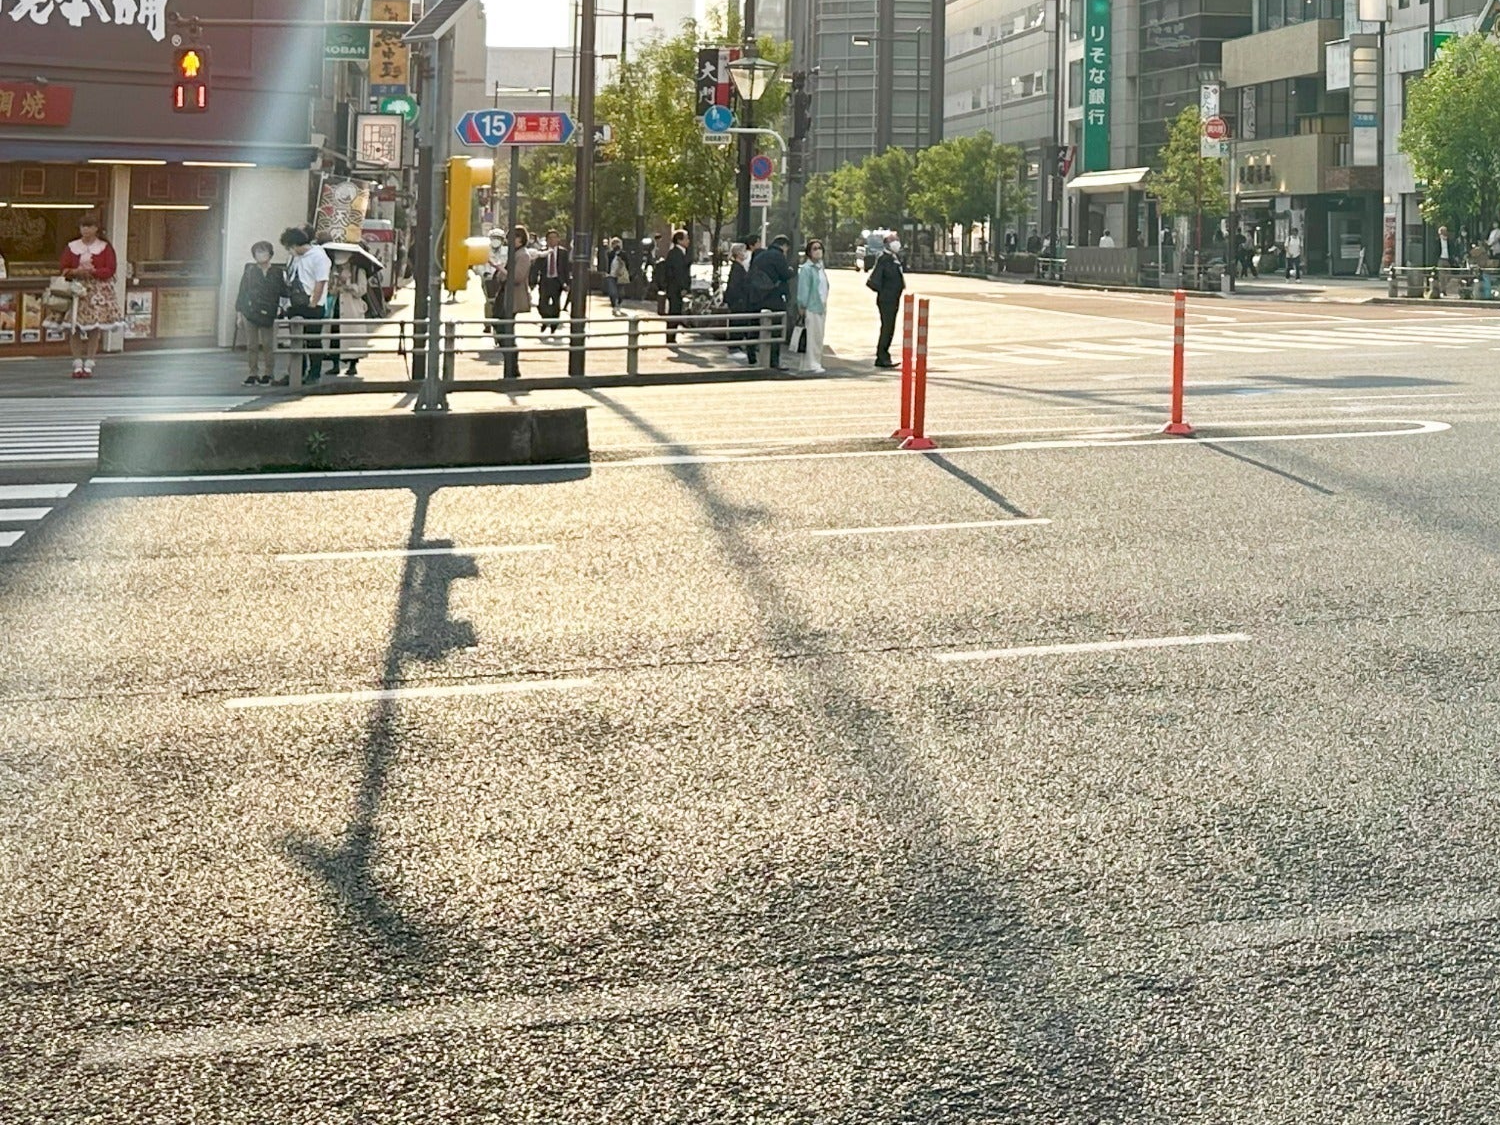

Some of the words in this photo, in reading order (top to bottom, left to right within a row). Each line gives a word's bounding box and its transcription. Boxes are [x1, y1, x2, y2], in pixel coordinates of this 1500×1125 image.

[1088, 25, 1107, 126] りそな銀行
[481, 115, 506, 136] 15
